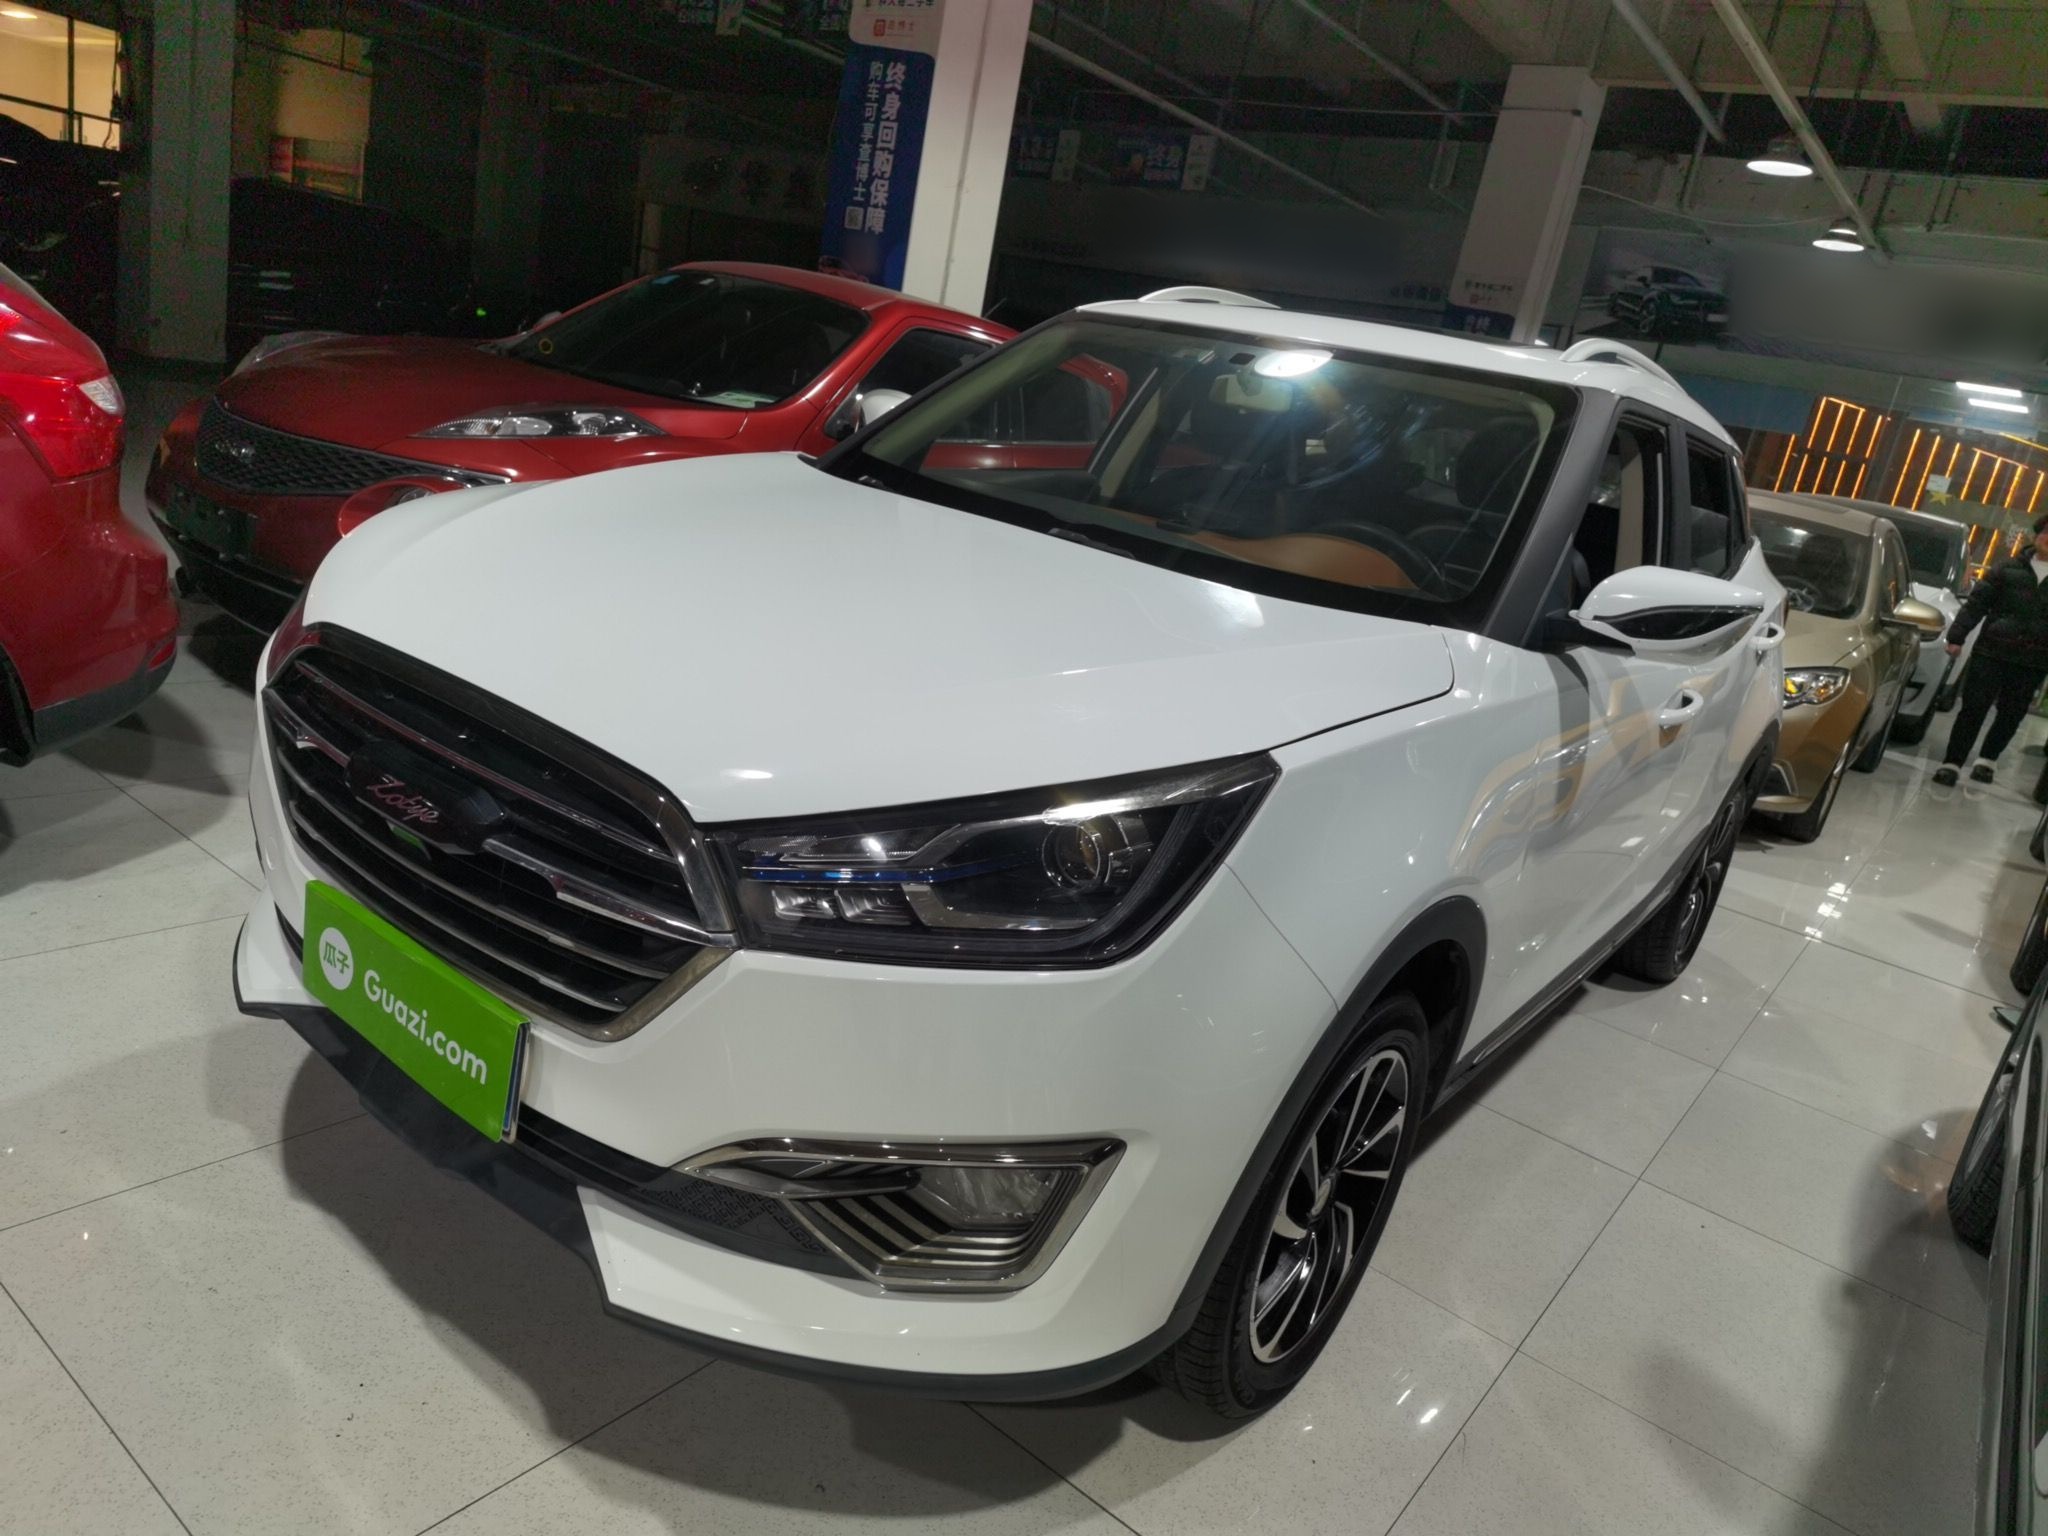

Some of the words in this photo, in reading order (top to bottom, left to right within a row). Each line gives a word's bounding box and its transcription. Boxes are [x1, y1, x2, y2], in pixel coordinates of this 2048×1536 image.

[853, 60, 884, 201] 购车可享查博士
[864, 61, 907, 235] 终身回购保障
[366, 774, 439, 823] Zotye
[323, 941, 350, 974] 瓜子
[363, 969, 488, 1085] Guazi.com
